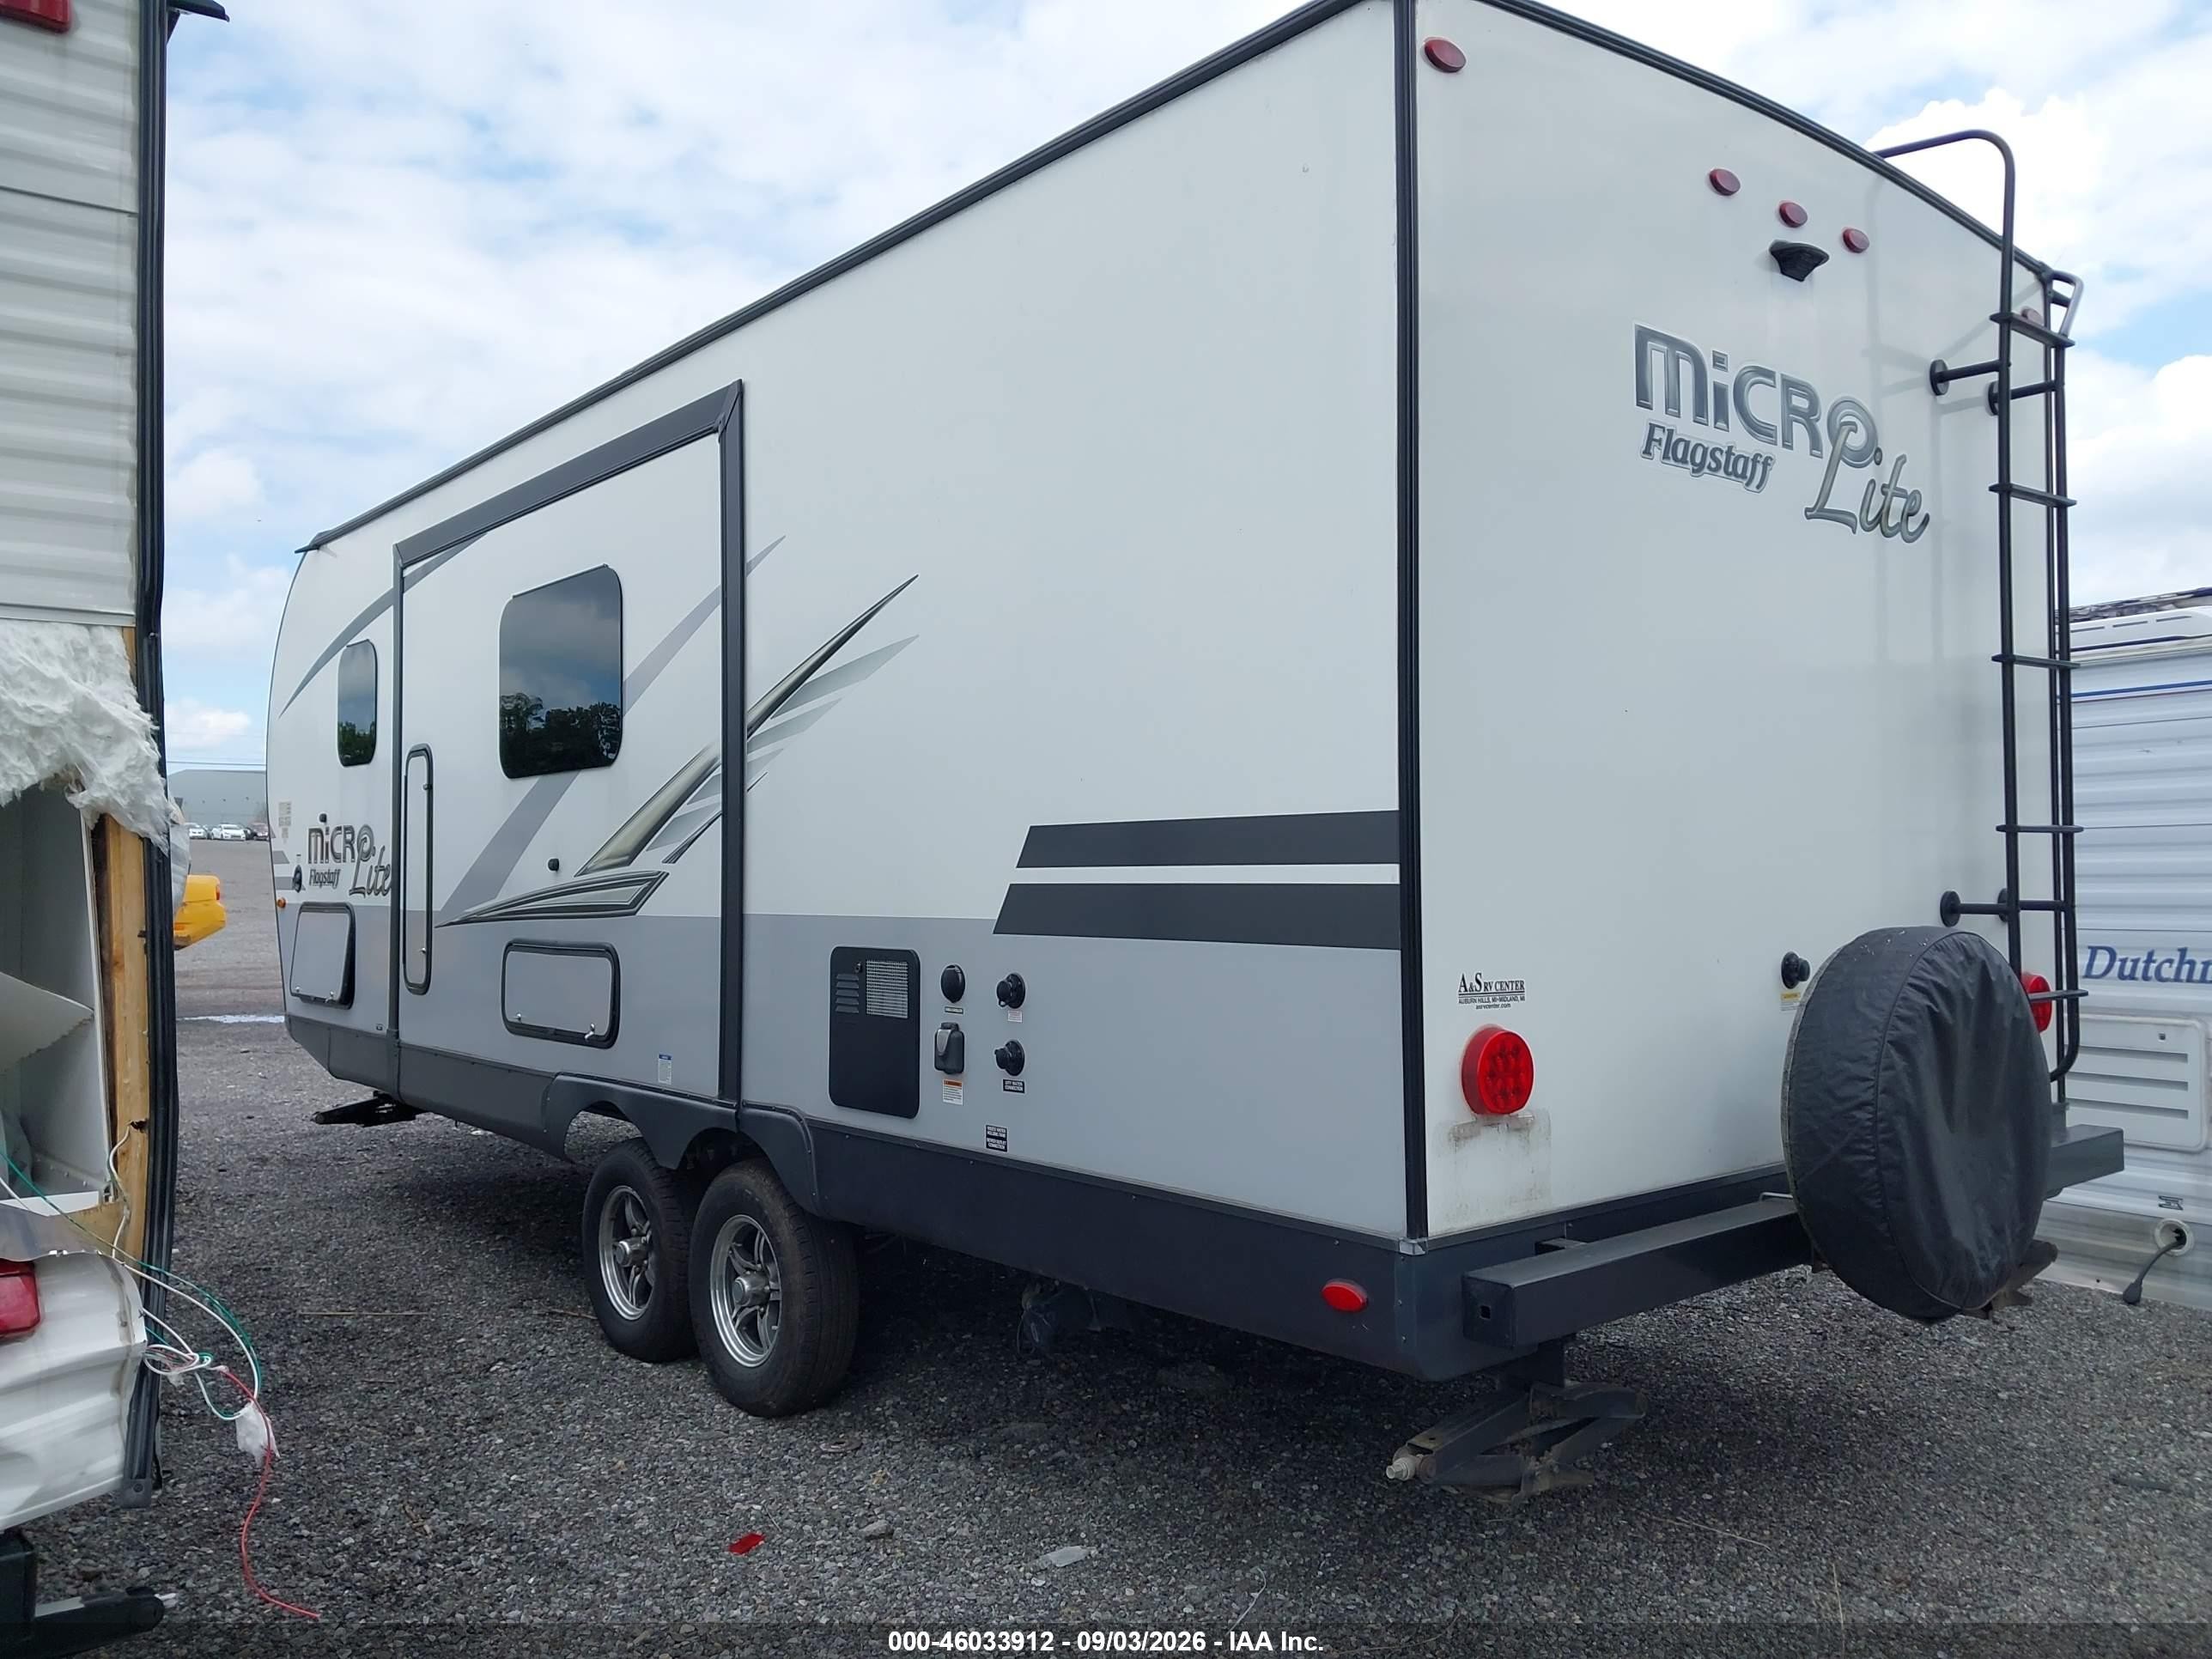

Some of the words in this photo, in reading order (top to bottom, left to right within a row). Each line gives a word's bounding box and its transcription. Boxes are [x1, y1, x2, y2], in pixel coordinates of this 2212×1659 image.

[1642, 422, 1773, 490] Flagstaff
[1803, 420, 1930, 544] Lite
[349, 836, 392, 898] Lite
[1458, 972, 1482, 993] A&S
[1484, 981, 1493, 992] RV
[1494, 980, 1525, 992] CENTER
